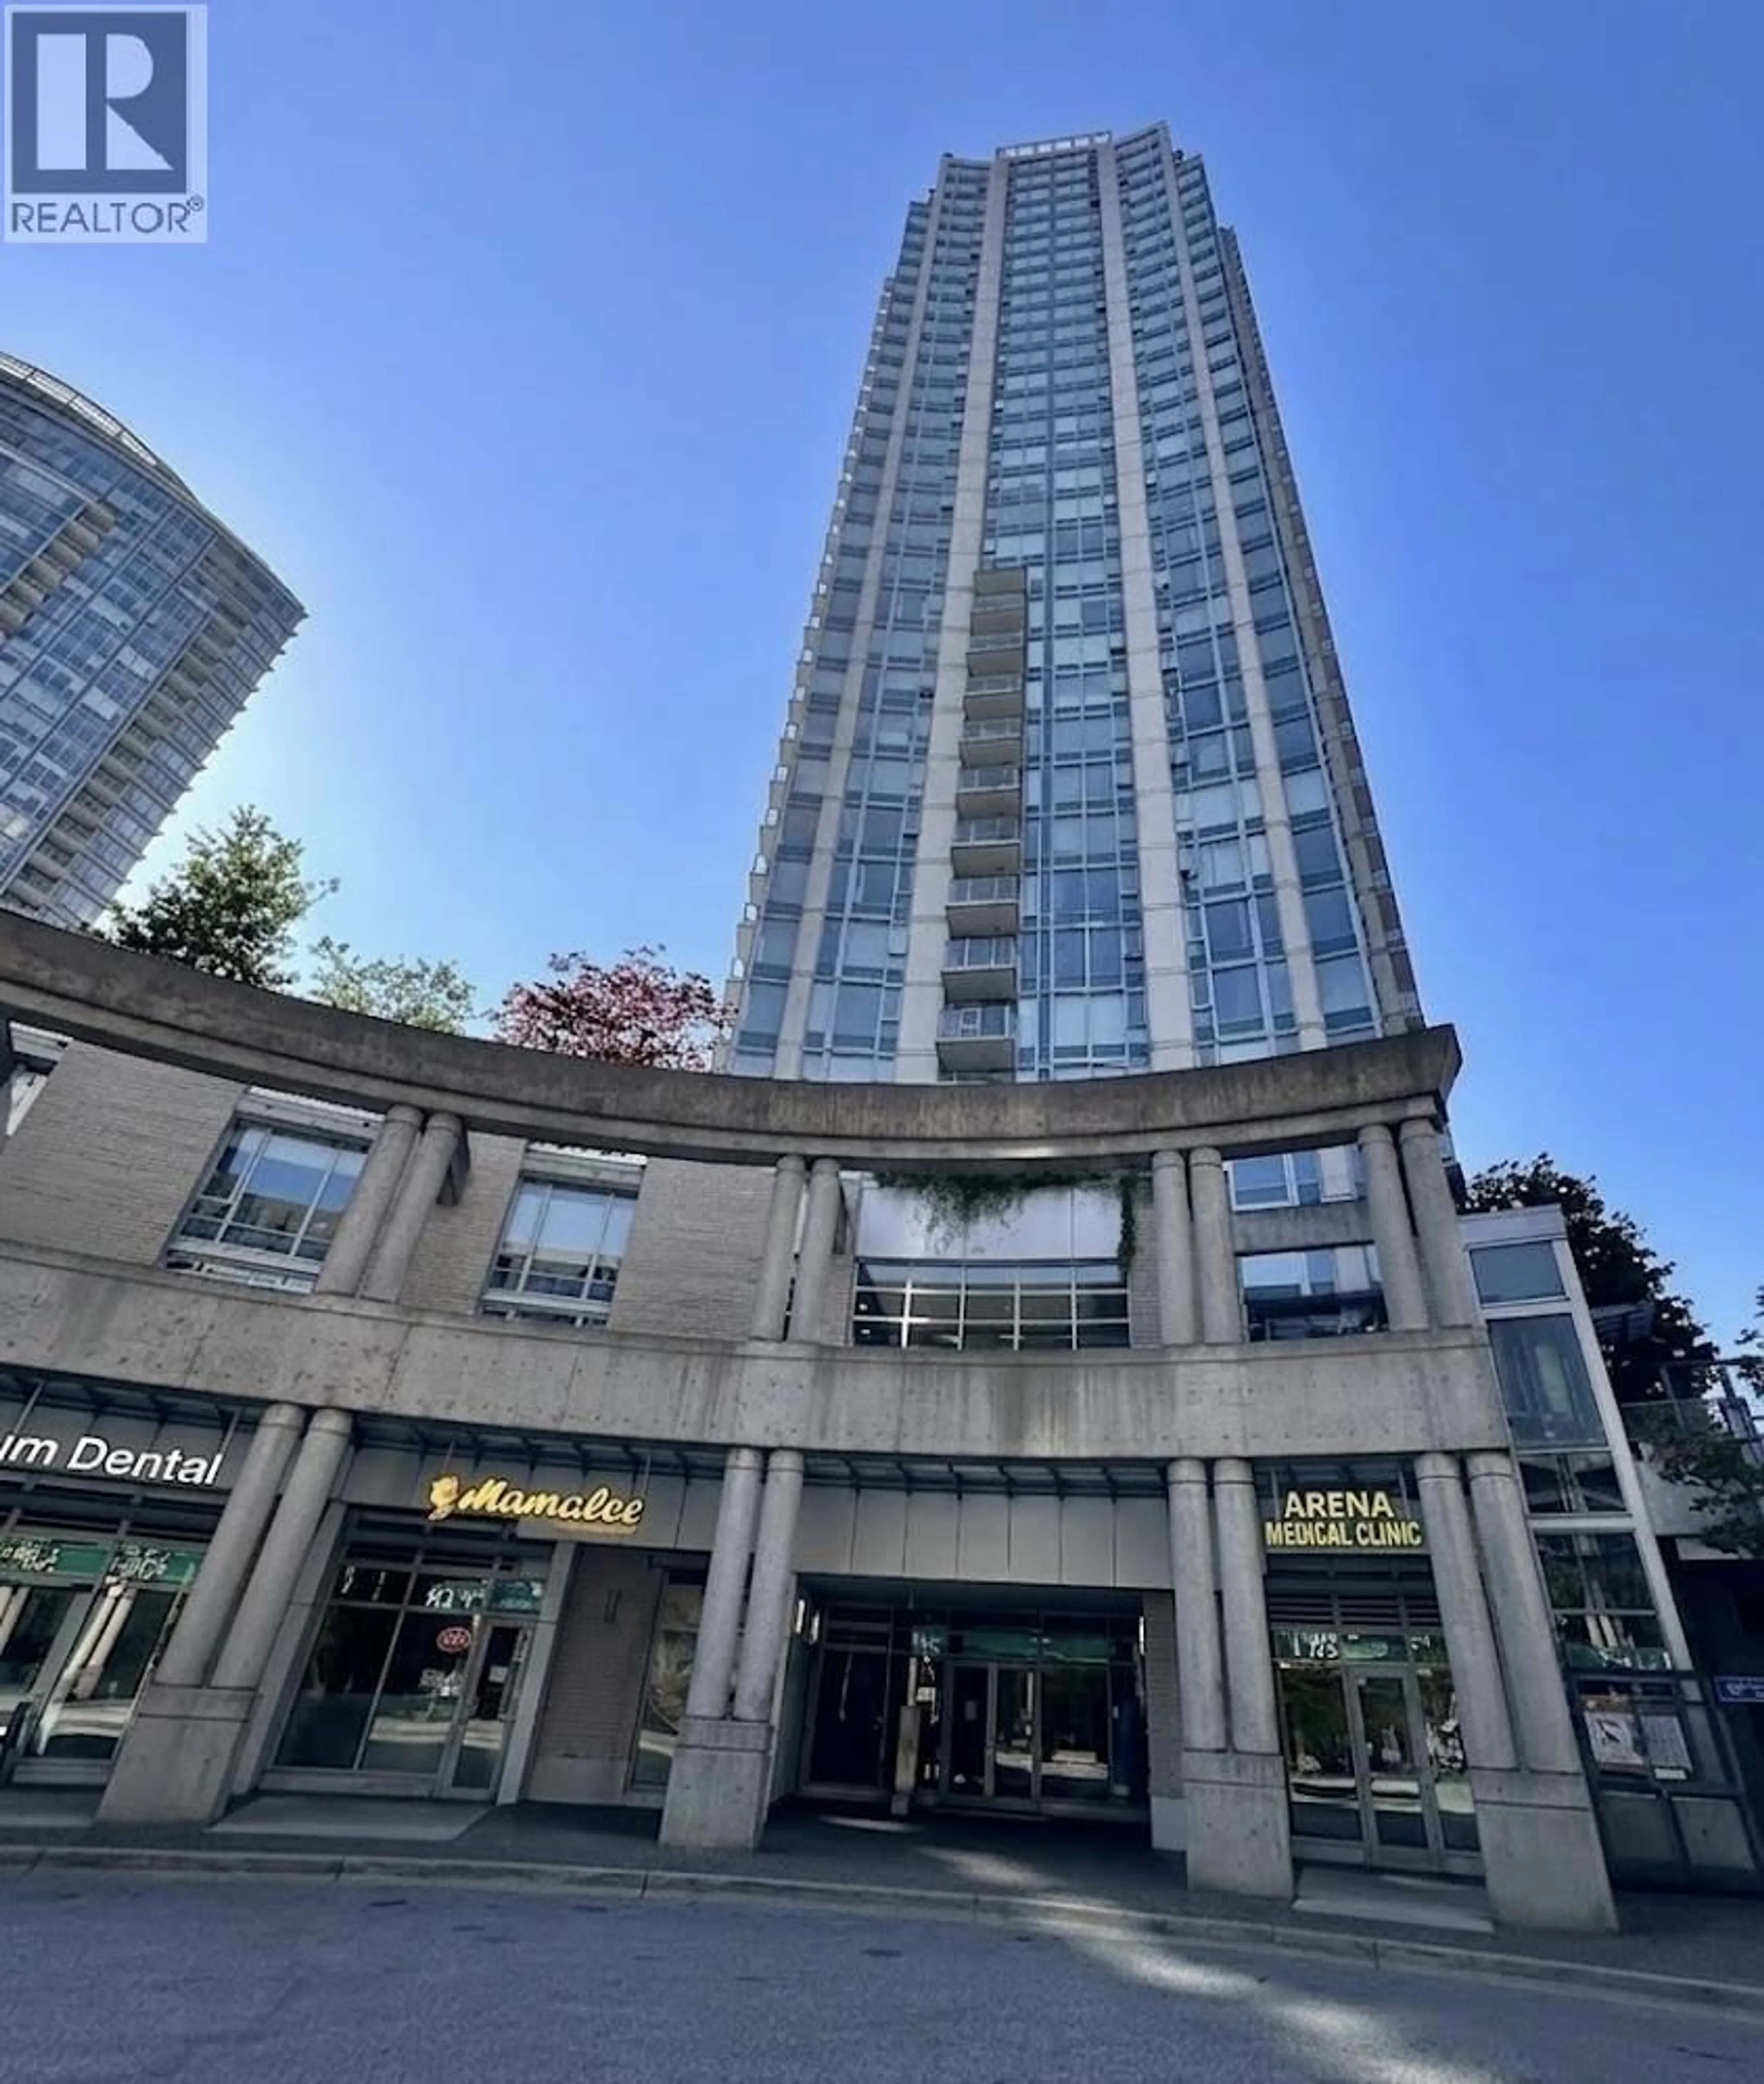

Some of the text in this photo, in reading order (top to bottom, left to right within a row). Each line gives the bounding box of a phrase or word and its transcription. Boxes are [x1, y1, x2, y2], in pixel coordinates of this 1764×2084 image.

[67, 1436, 223, 1485] Dental
[1285, 1491, 1395, 1518] ARENA
[1266, 1521, 1422, 1546] MEDICAL CLINIC
